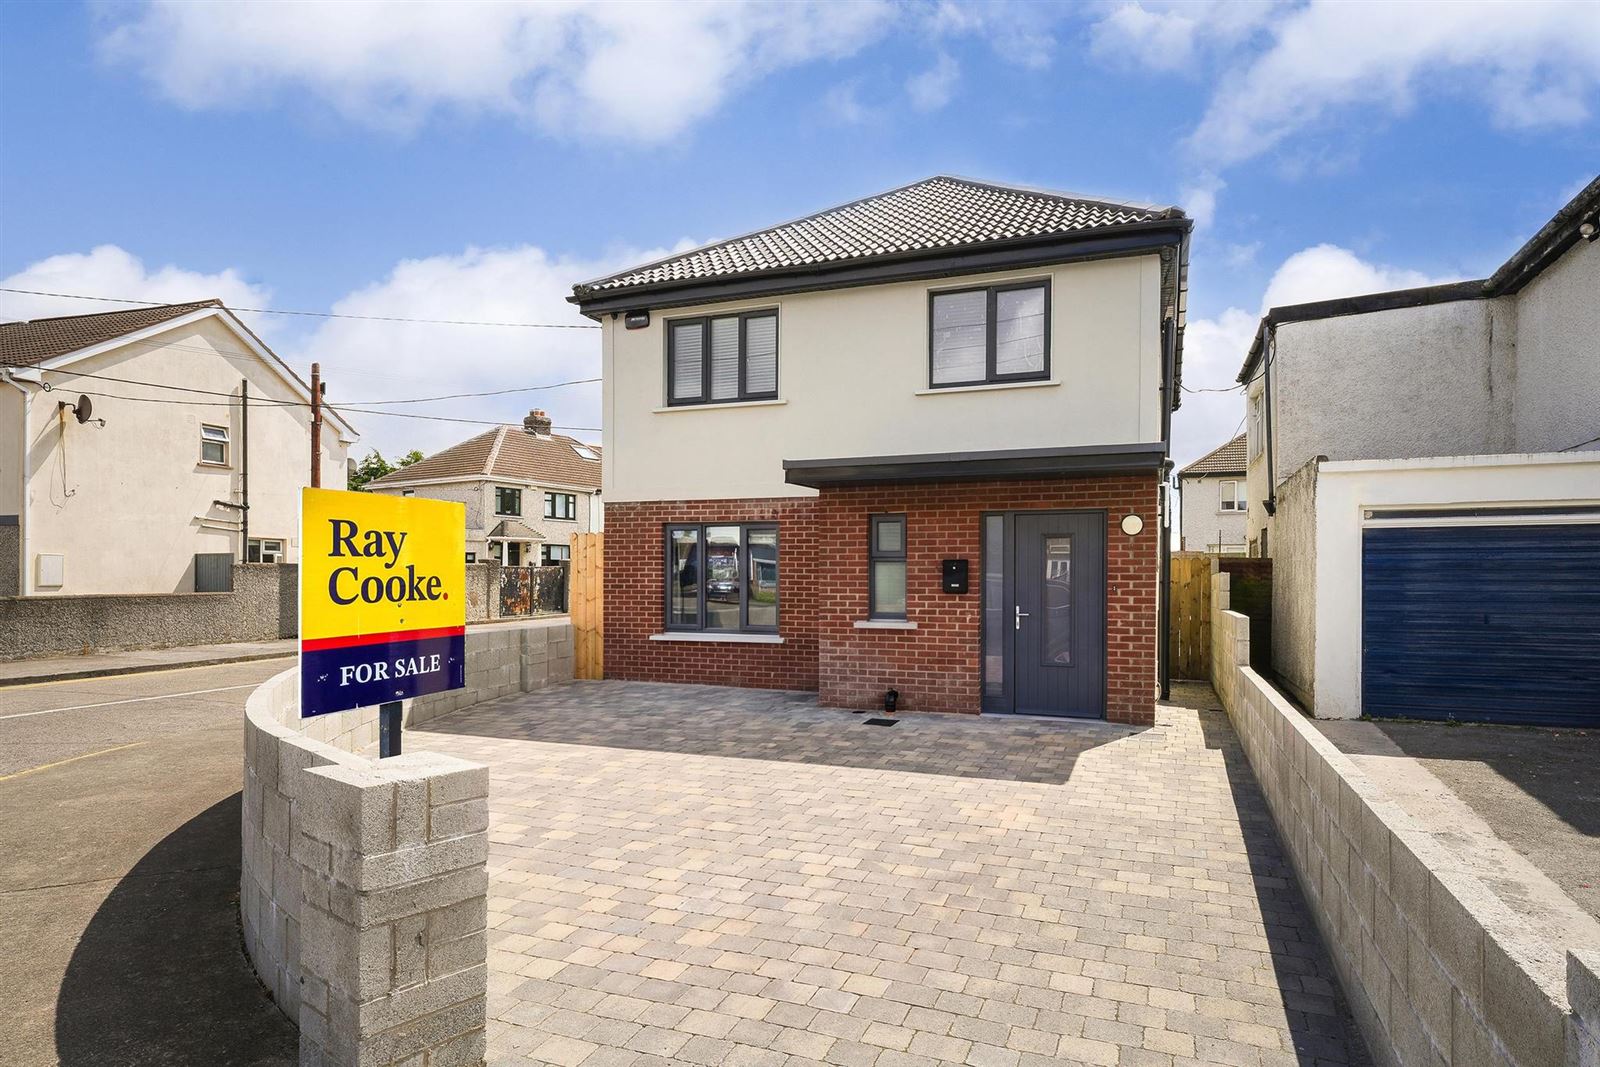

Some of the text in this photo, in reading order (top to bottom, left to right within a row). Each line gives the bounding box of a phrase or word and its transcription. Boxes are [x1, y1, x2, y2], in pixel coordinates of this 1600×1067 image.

[328, 519, 408, 569] Ray
[328, 565, 449, 605] Cooke.
[340, 661, 390, 687] FOR
[395, 654, 441, 678] SALE
